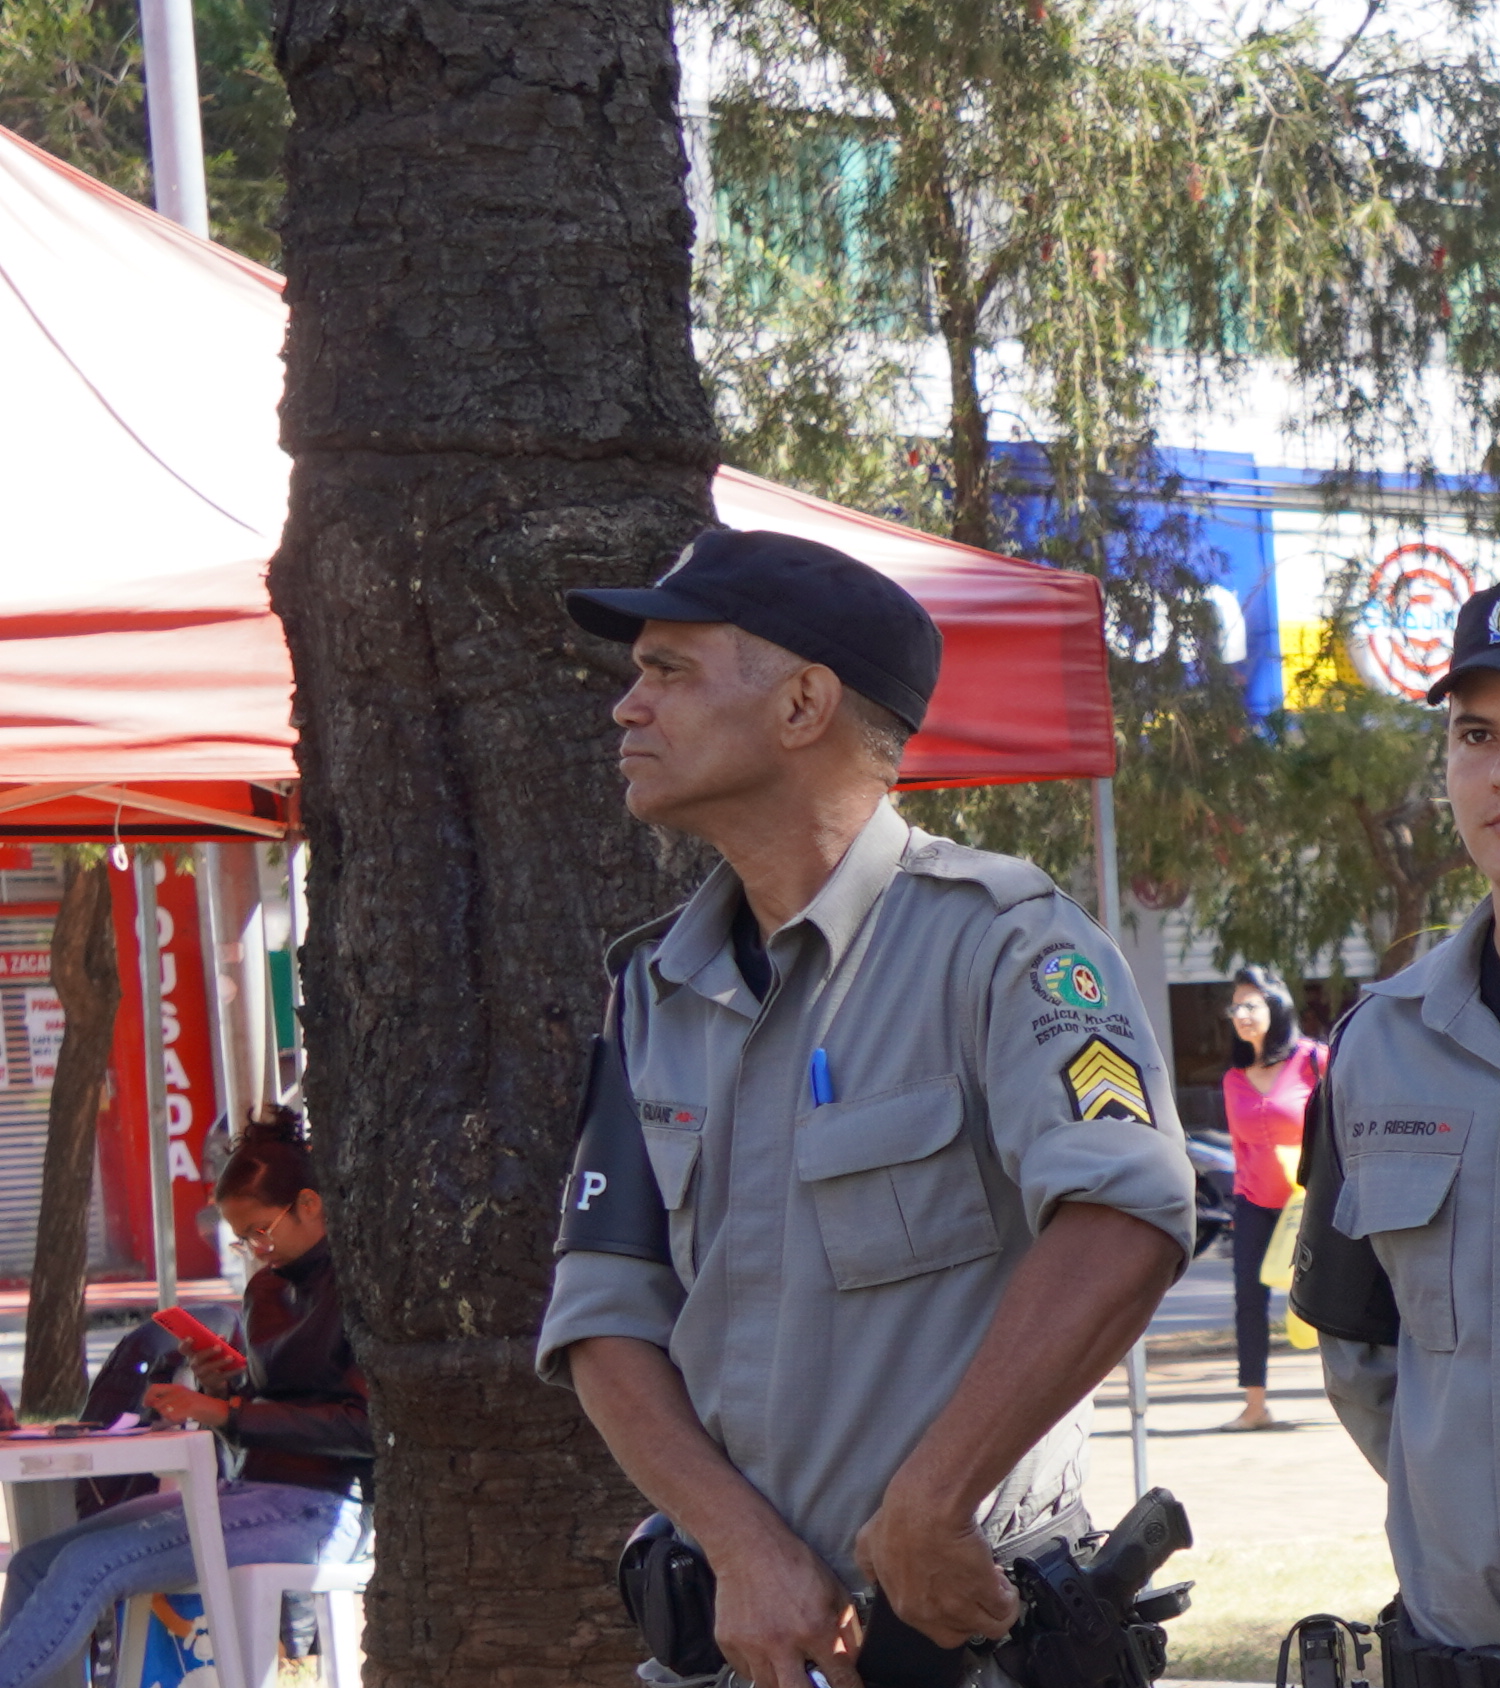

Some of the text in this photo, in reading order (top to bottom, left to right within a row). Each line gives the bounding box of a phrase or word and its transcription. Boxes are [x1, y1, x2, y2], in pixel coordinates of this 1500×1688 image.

[1031, 1007, 1131, 1032] POLÍCIA MILITAR
[1034, 1022, 1080, 1047] ESTADO
[1383, 1119, 1437, 1136] RIBEIRO
